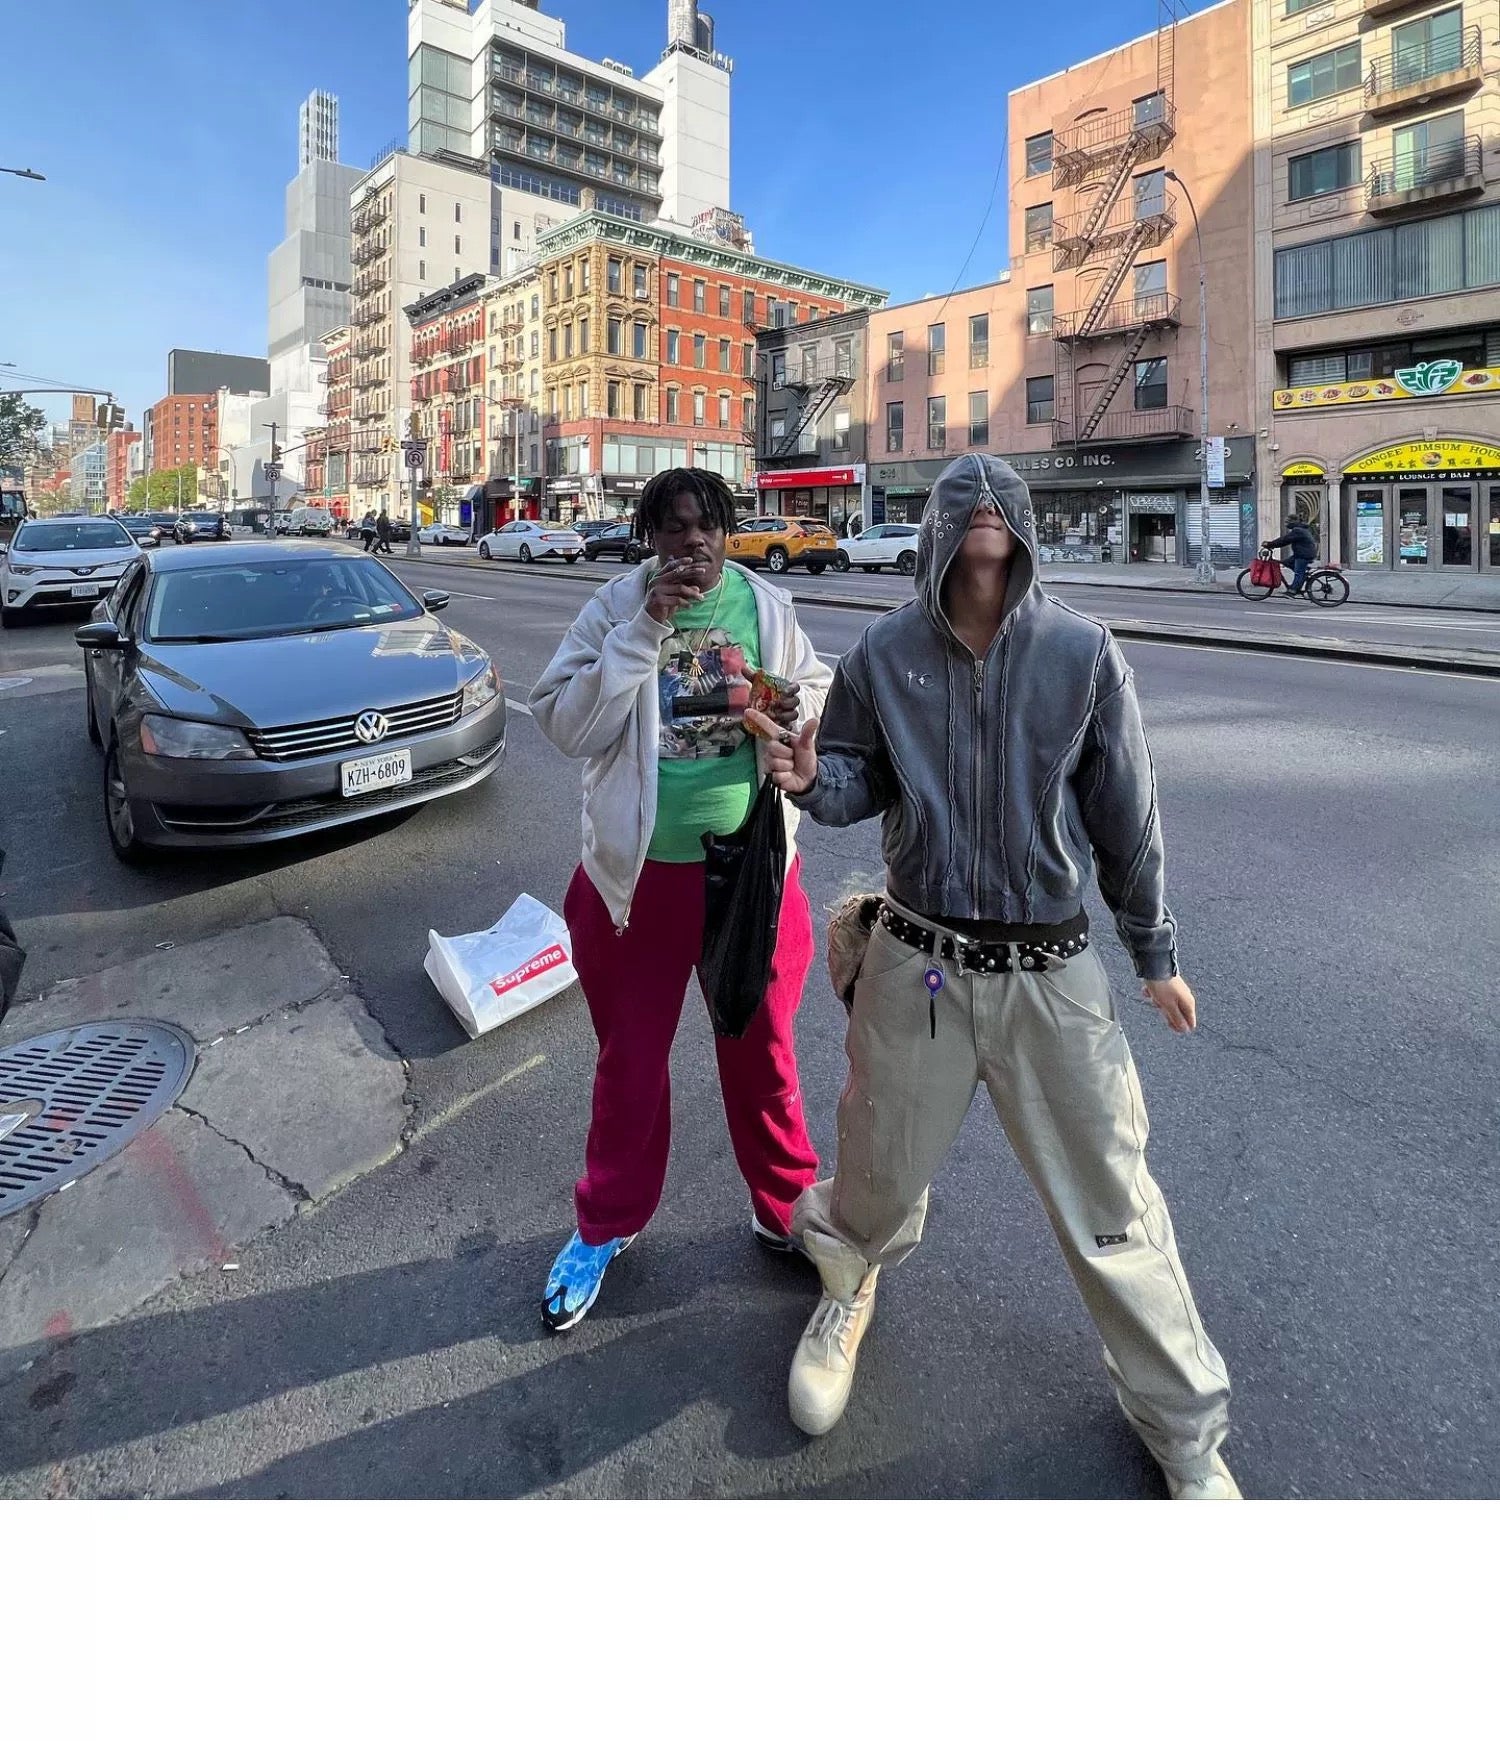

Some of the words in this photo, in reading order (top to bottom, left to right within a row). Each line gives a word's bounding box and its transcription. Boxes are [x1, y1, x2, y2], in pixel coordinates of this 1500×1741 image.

[1054, 456, 1078, 469] CO.
[1082, 454, 1115, 466] INC.
[1359, 449, 1403, 469] CONGEE
[1410, 443, 1461, 453] DIMSUM
[1450, 471, 1471, 479] BAR
[495, 949, 562, 989] Supreme
